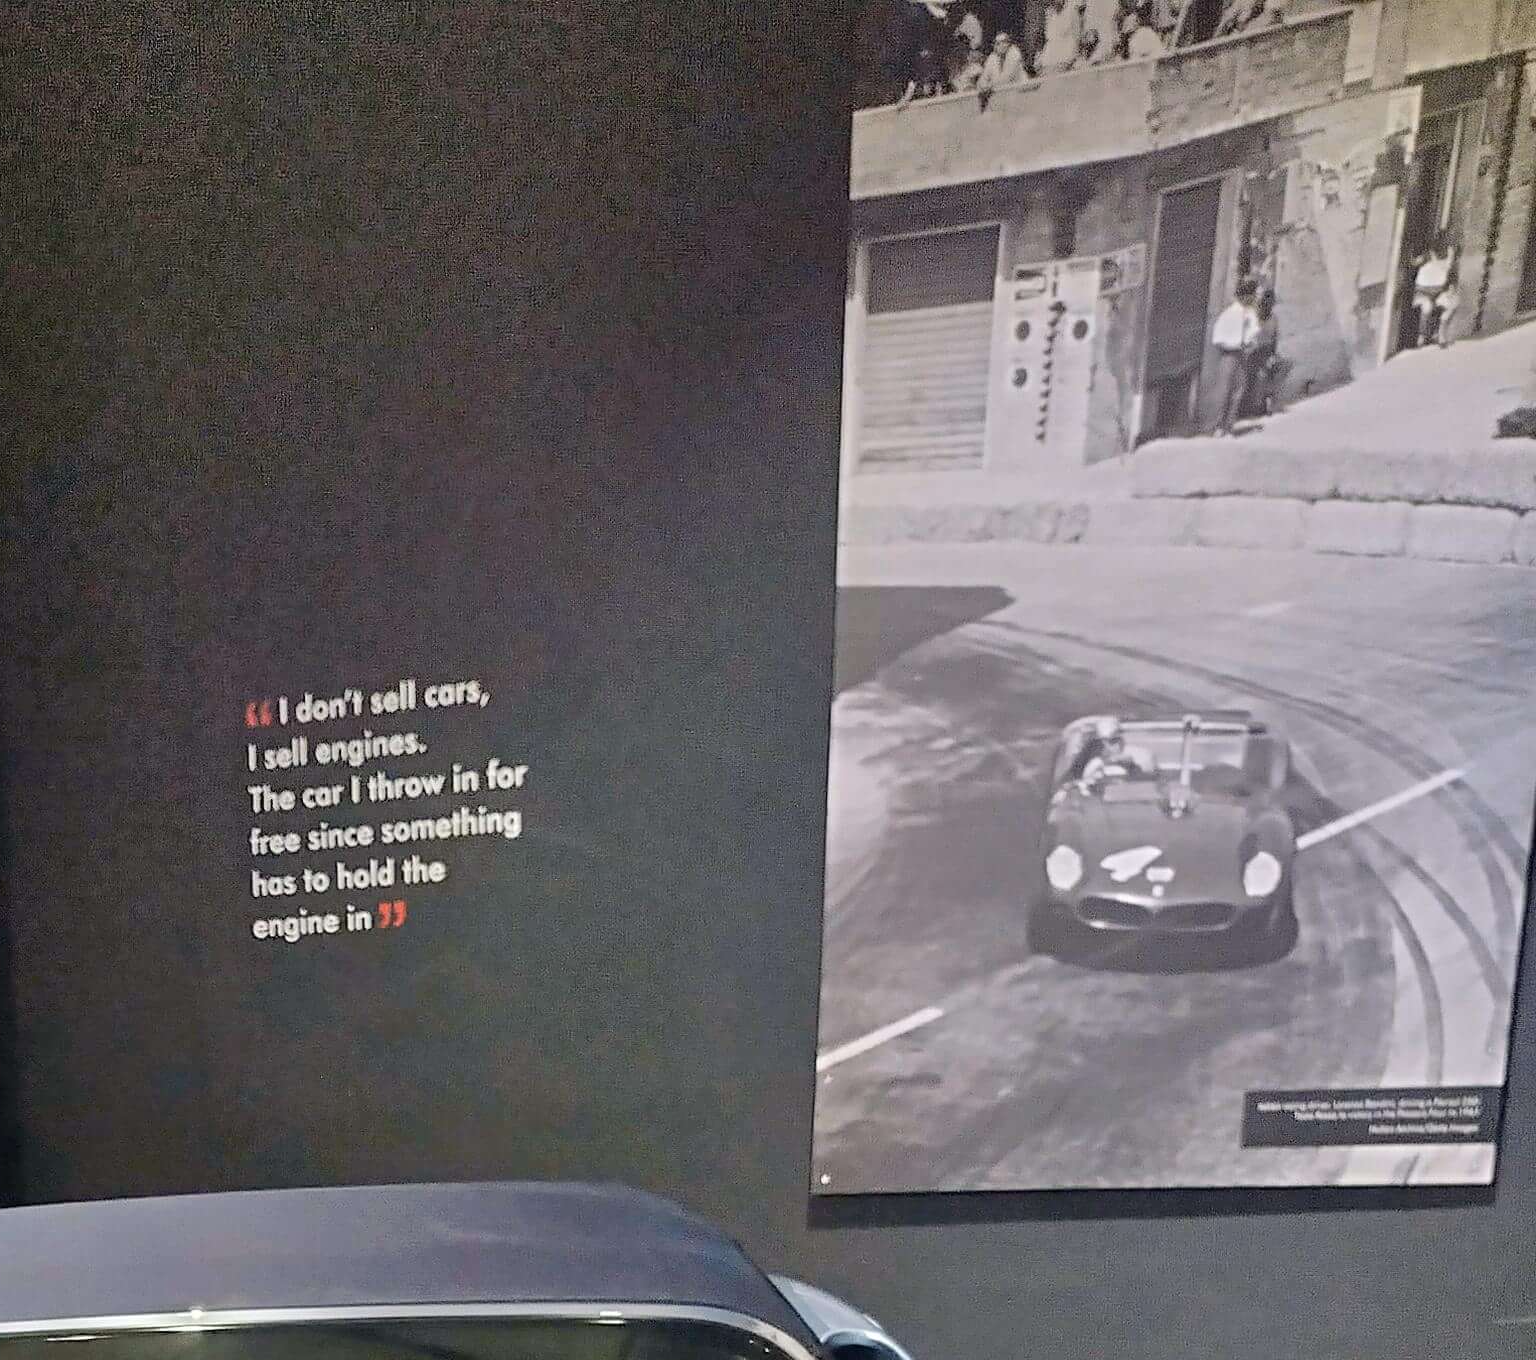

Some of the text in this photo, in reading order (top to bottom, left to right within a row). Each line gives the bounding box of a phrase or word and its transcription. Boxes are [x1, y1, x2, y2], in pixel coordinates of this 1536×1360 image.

[295, 689, 363, 723] don't
[370, 680, 416, 715] sell
[424, 680, 491, 708] cars,
[247, 730, 427, 771] I sell engines.
[247, 758, 528, 813] The car I throw in for
[249, 805, 522, 855] free since something
[251, 854, 447, 898] has to hold the
[252, 904, 373, 943] engine in
